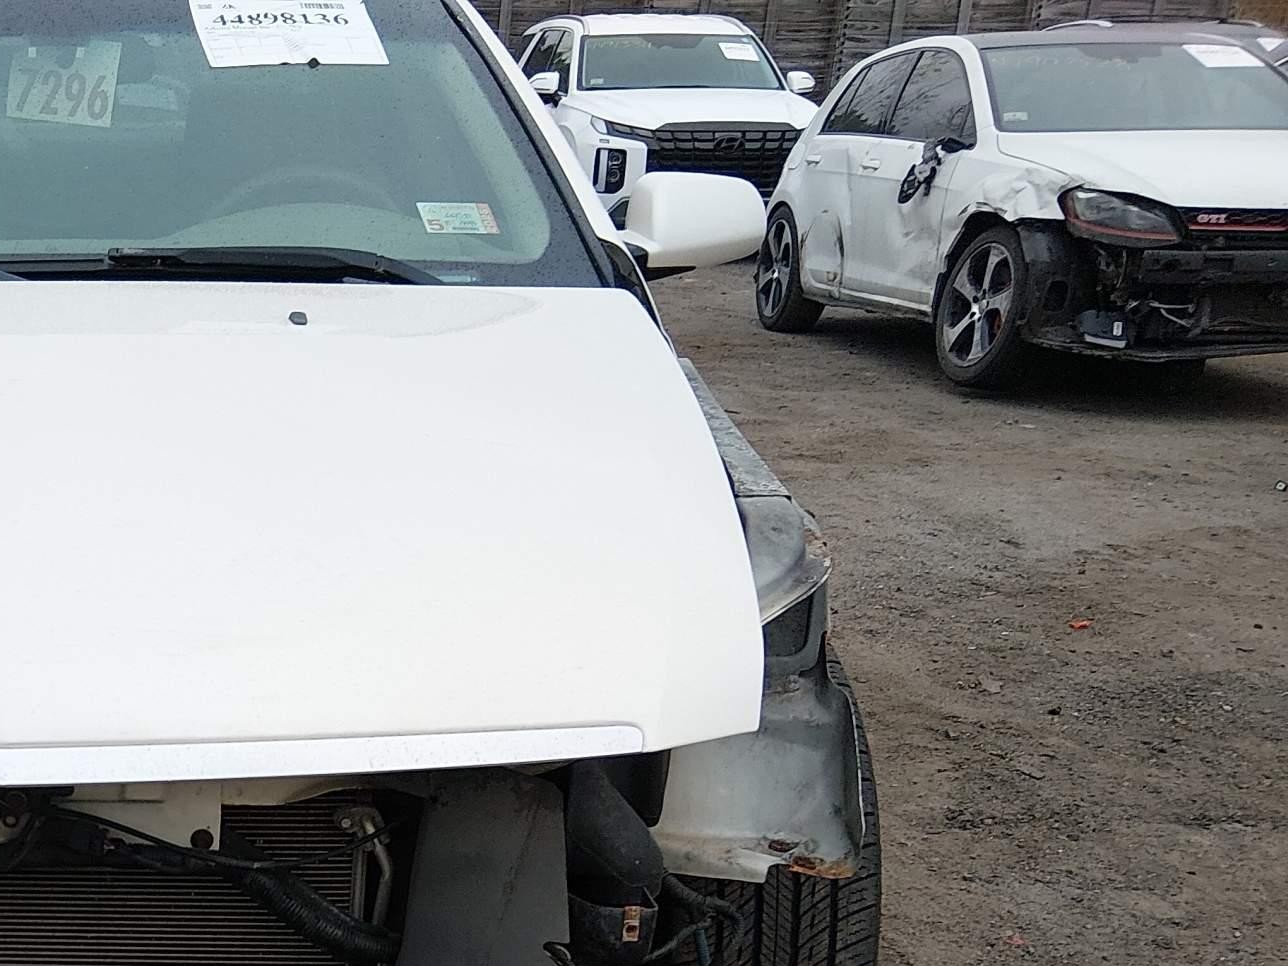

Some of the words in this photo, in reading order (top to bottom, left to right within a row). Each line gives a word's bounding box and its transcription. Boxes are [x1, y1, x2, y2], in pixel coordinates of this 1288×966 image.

[212, 12, 350, 26] 44898136
[15, 67, 109, 121] 7296
[1197, 214, 1227, 224] GTI
